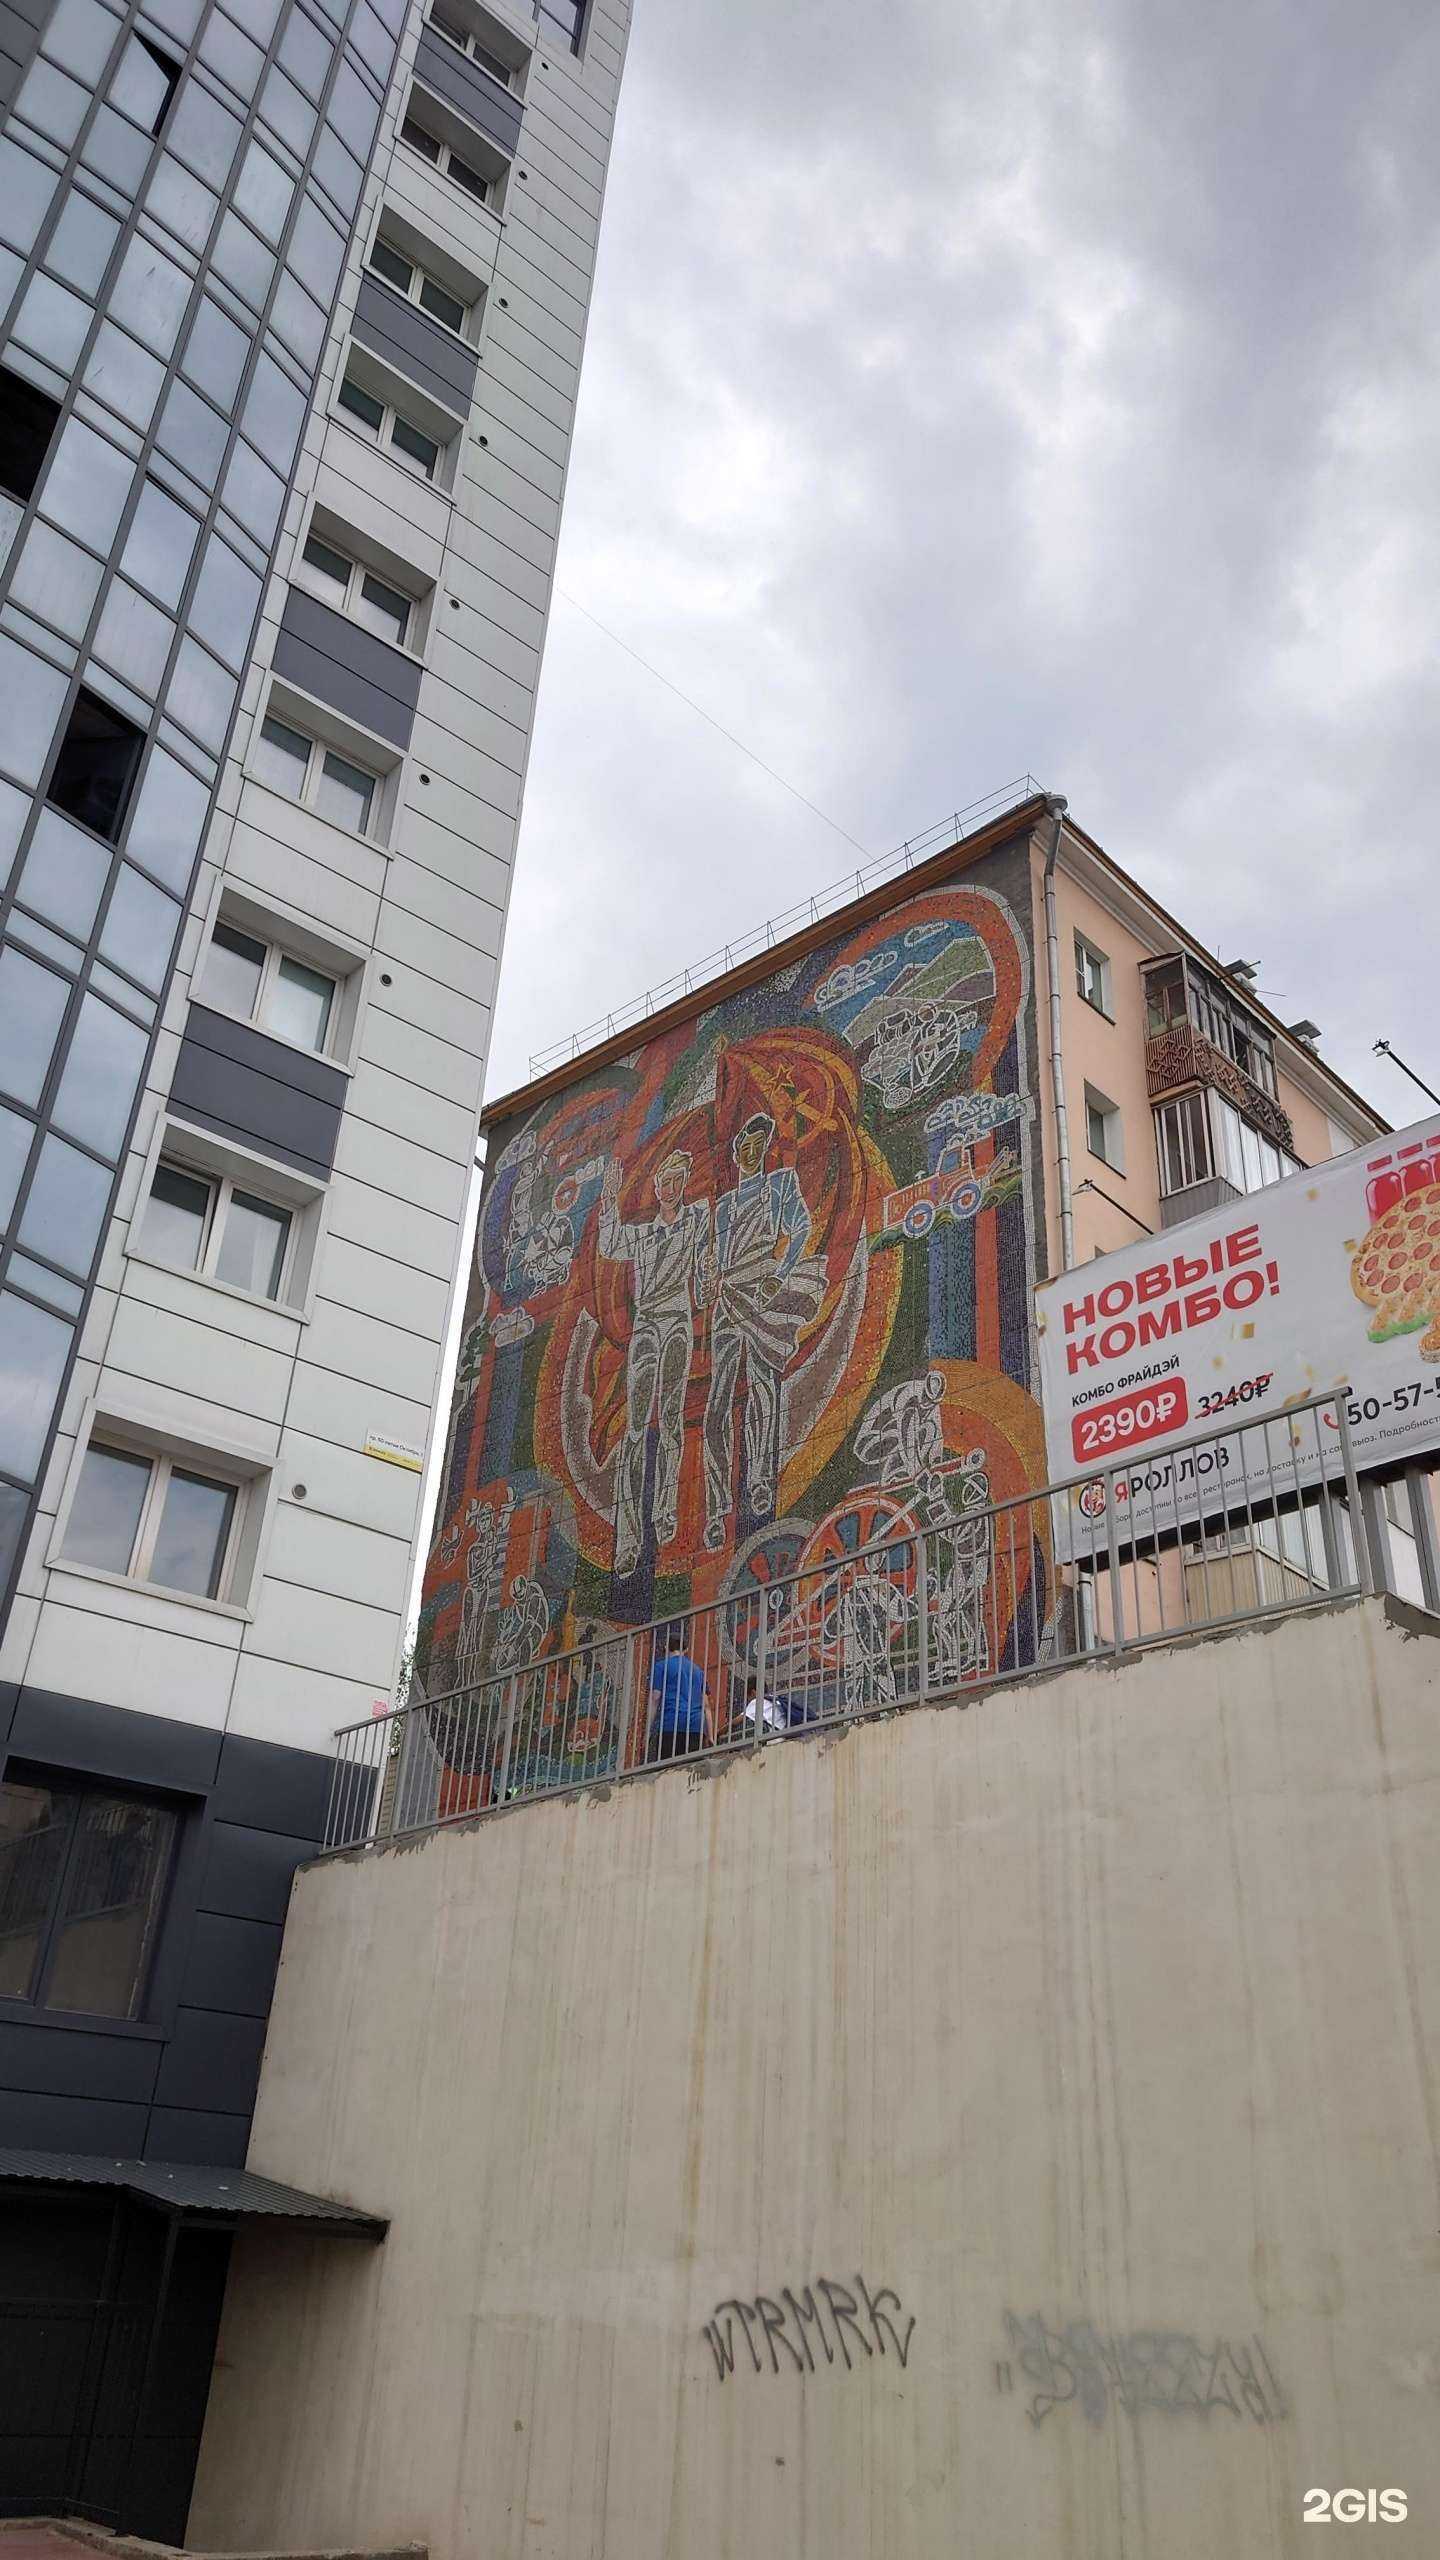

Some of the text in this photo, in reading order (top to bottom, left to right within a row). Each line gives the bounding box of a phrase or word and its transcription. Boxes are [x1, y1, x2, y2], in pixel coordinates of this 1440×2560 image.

[1063, 1224, 1262, 1334] НОВЫЕ
[1066, 1261, 1280, 1375] КОМБО!
[1072, 1354, 1180, 1407] КОМБО ФРАЙДЭЙ
[1081, 1391, 1177, 1450] 2390₽
